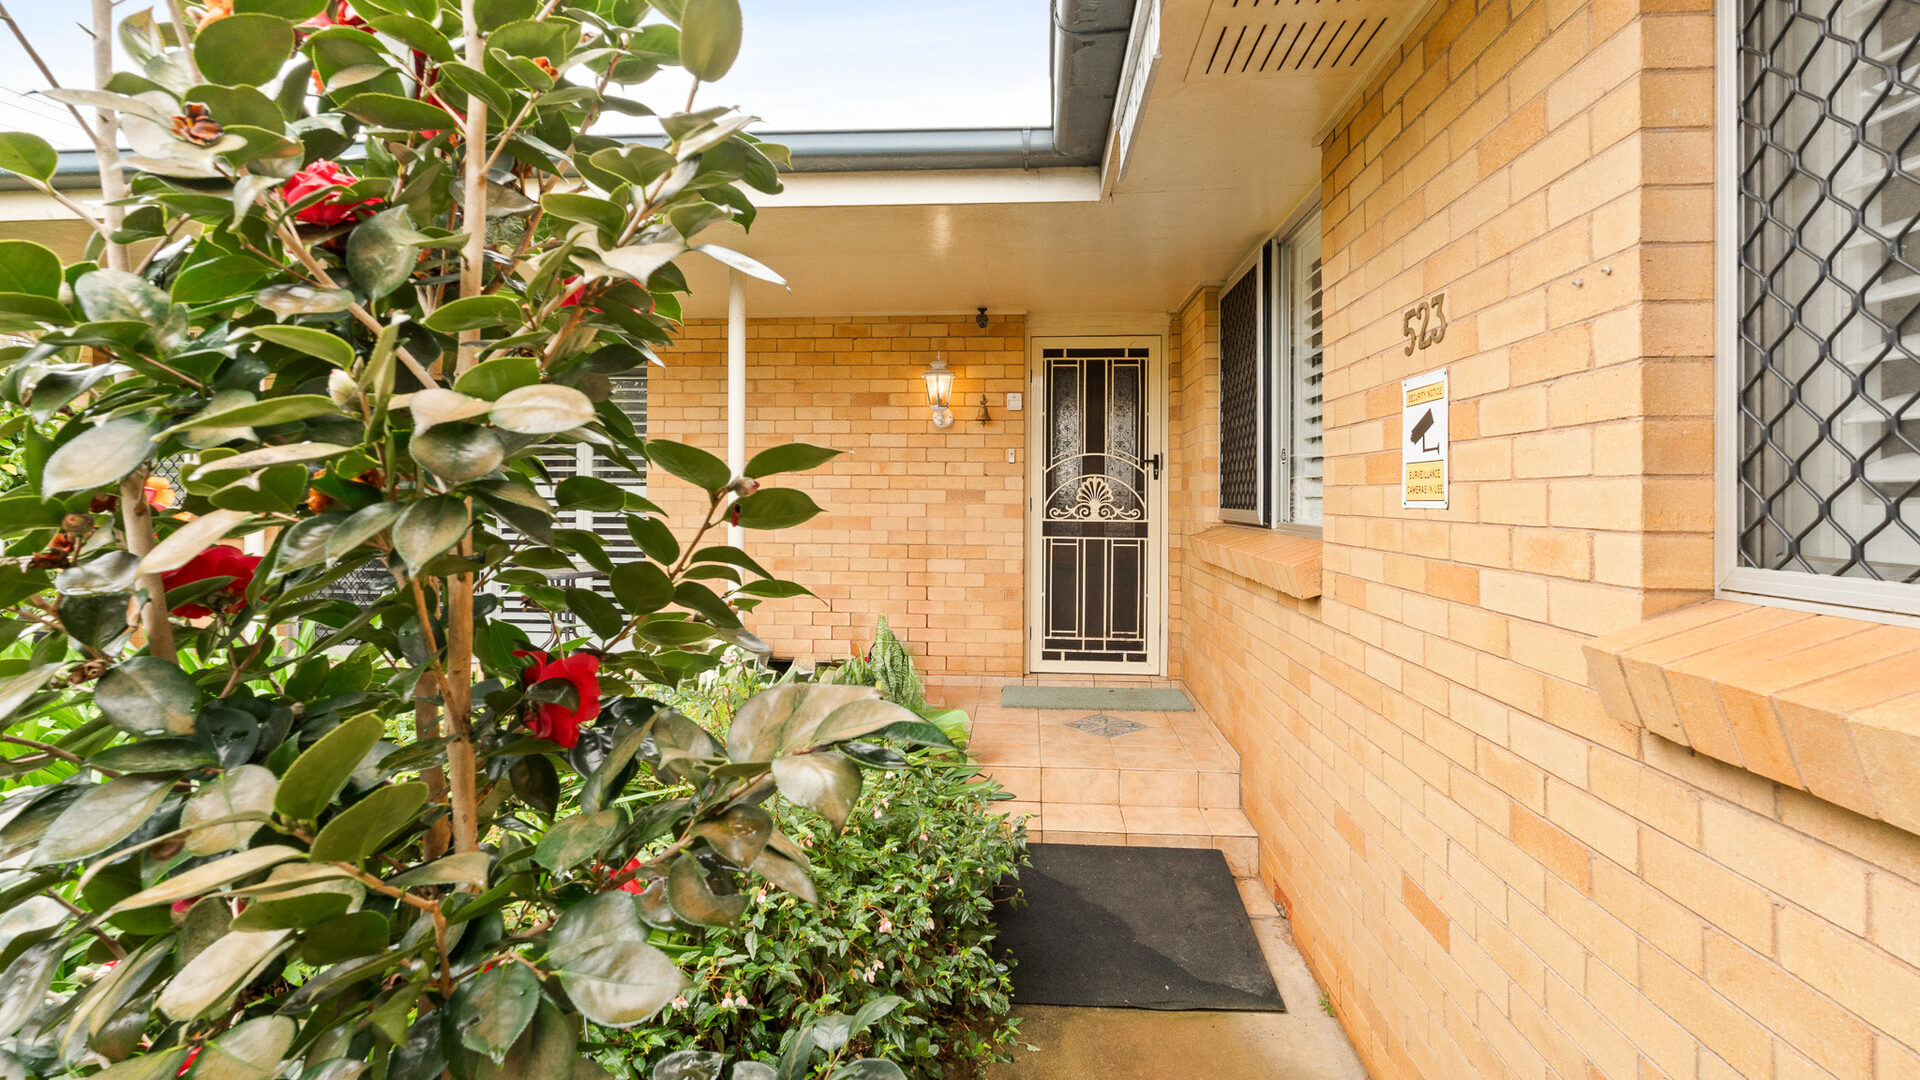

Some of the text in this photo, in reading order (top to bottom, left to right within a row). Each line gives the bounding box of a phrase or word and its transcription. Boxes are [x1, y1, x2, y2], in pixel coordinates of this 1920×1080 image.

[1404, 293, 1446, 357] 523
[1408, 387, 1442, 403] SECURITY NOTICE
[1408, 469, 1441, 480] SURVEILLANCE
[1407, 484, 1443, 495] CAMERAS IN USE
